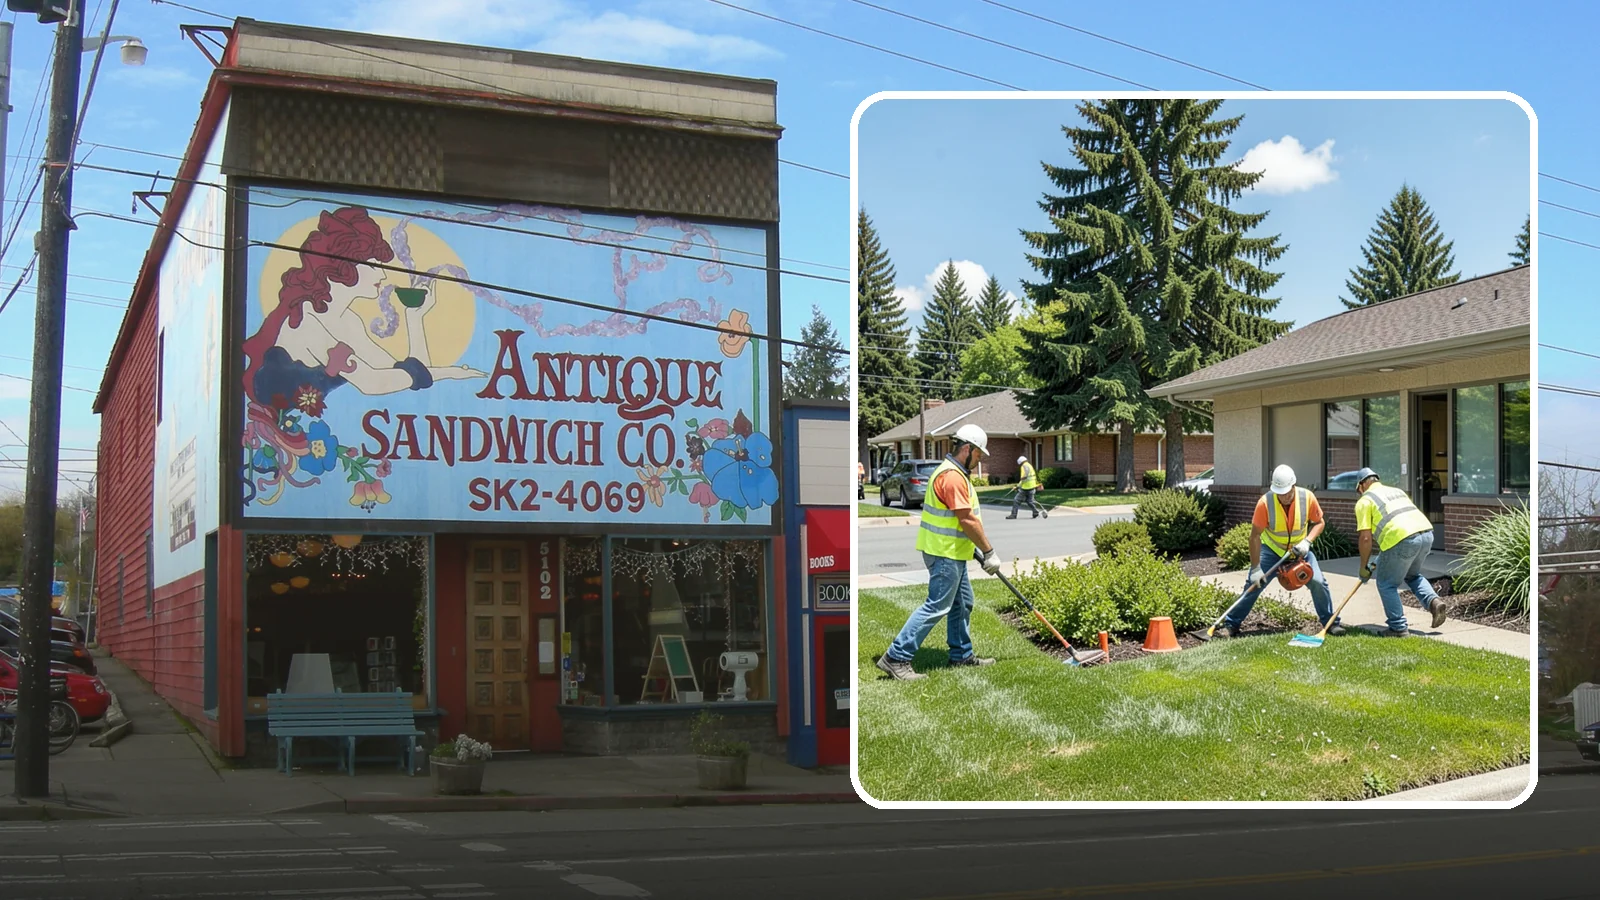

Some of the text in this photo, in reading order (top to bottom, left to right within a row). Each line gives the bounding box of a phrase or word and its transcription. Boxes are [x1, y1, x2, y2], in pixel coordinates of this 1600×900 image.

[477, 329, 723, 421] ANTIQUE
[361, 408, 685, 469] SANDWICH CO.
[469, 477, 646, 513] SK2-4069
[539, 541, 552, 600] 5102
[809, 554, 835, 569] BOOKS
